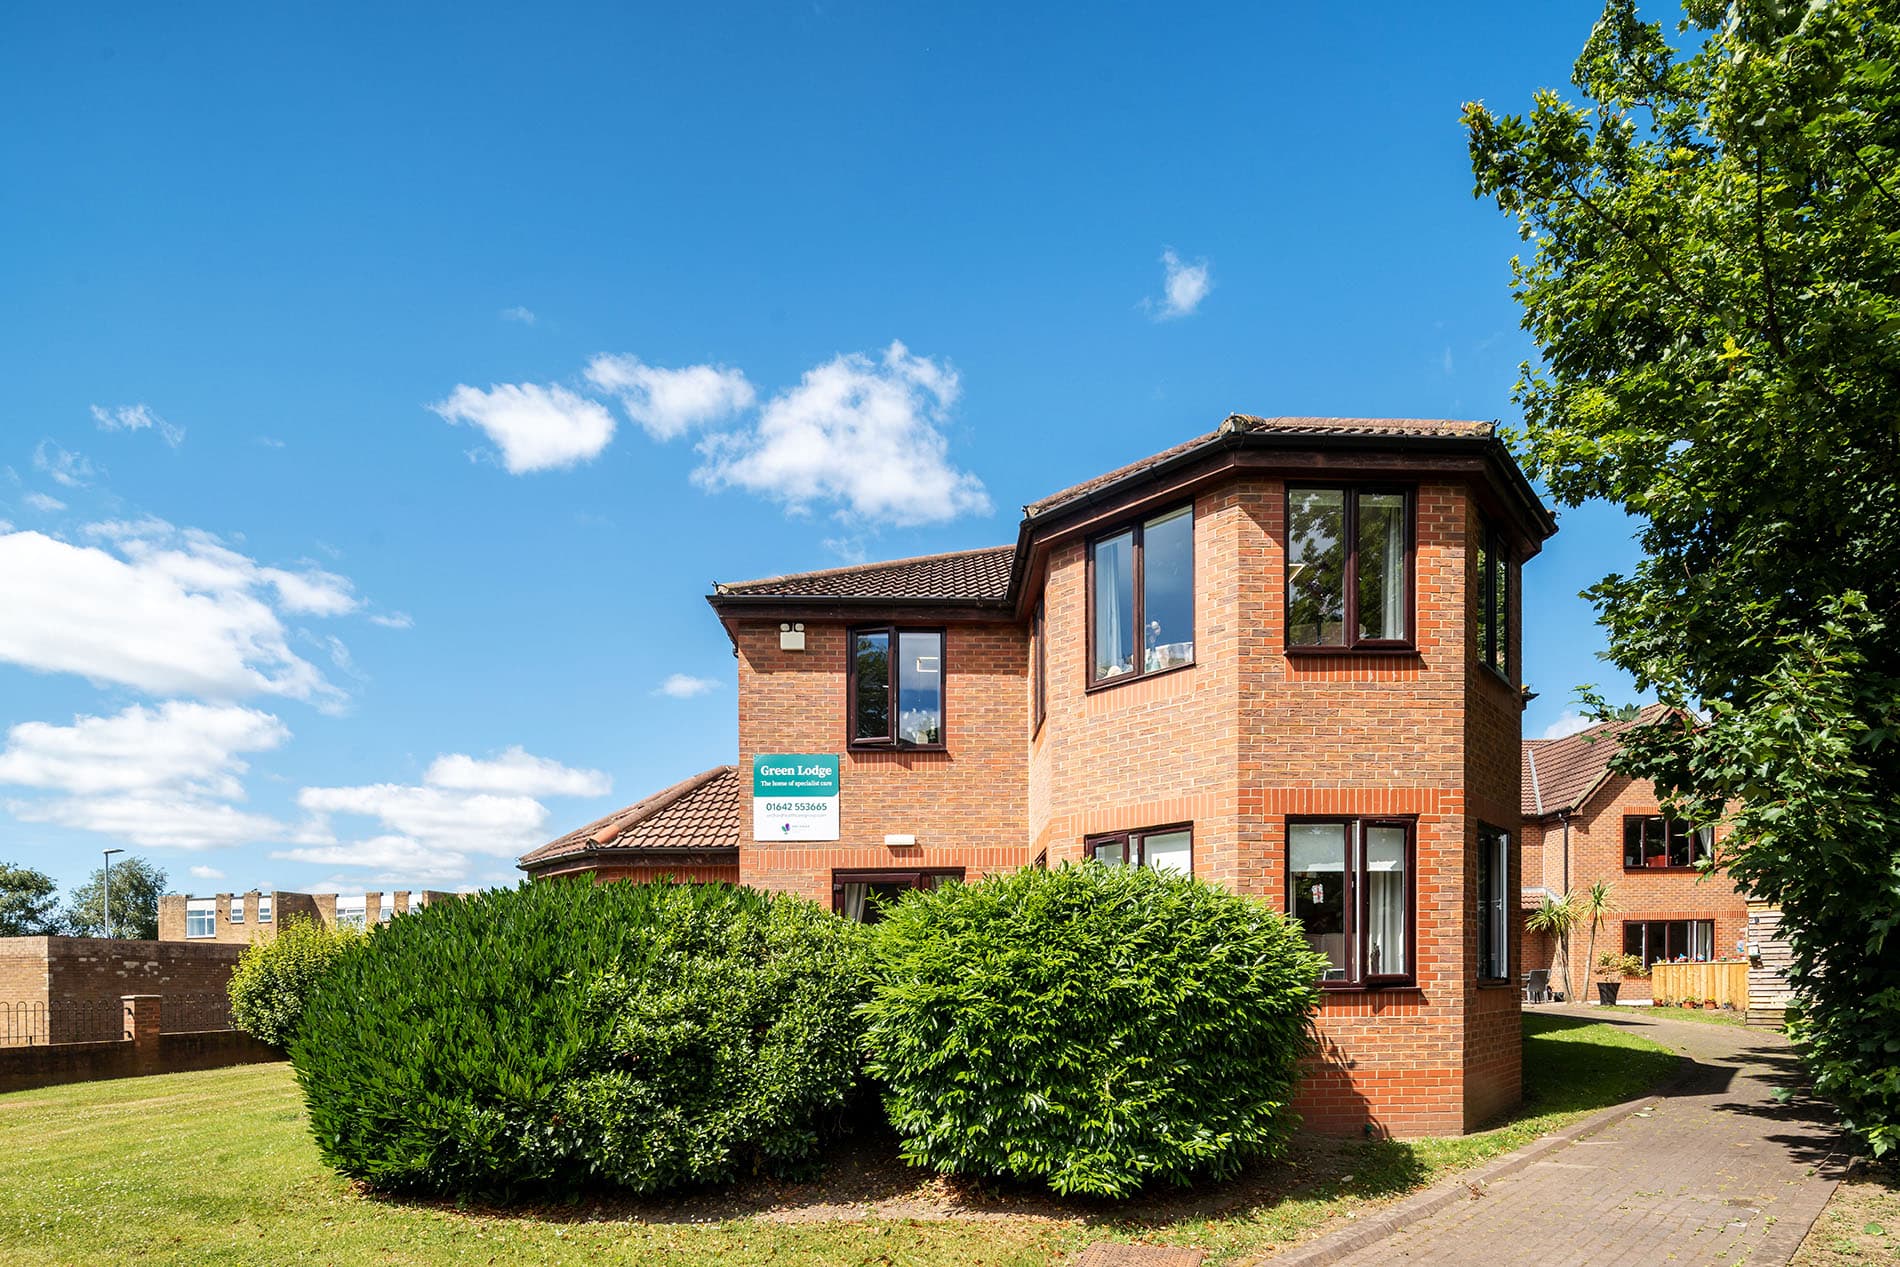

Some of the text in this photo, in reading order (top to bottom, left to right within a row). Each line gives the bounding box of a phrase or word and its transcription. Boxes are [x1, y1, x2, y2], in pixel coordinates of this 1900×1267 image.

[760, 764, 832, 778] Green Lodge
[795, 780, 820, 788] specialist
[766, 802, 828, 811] 01642 553665
